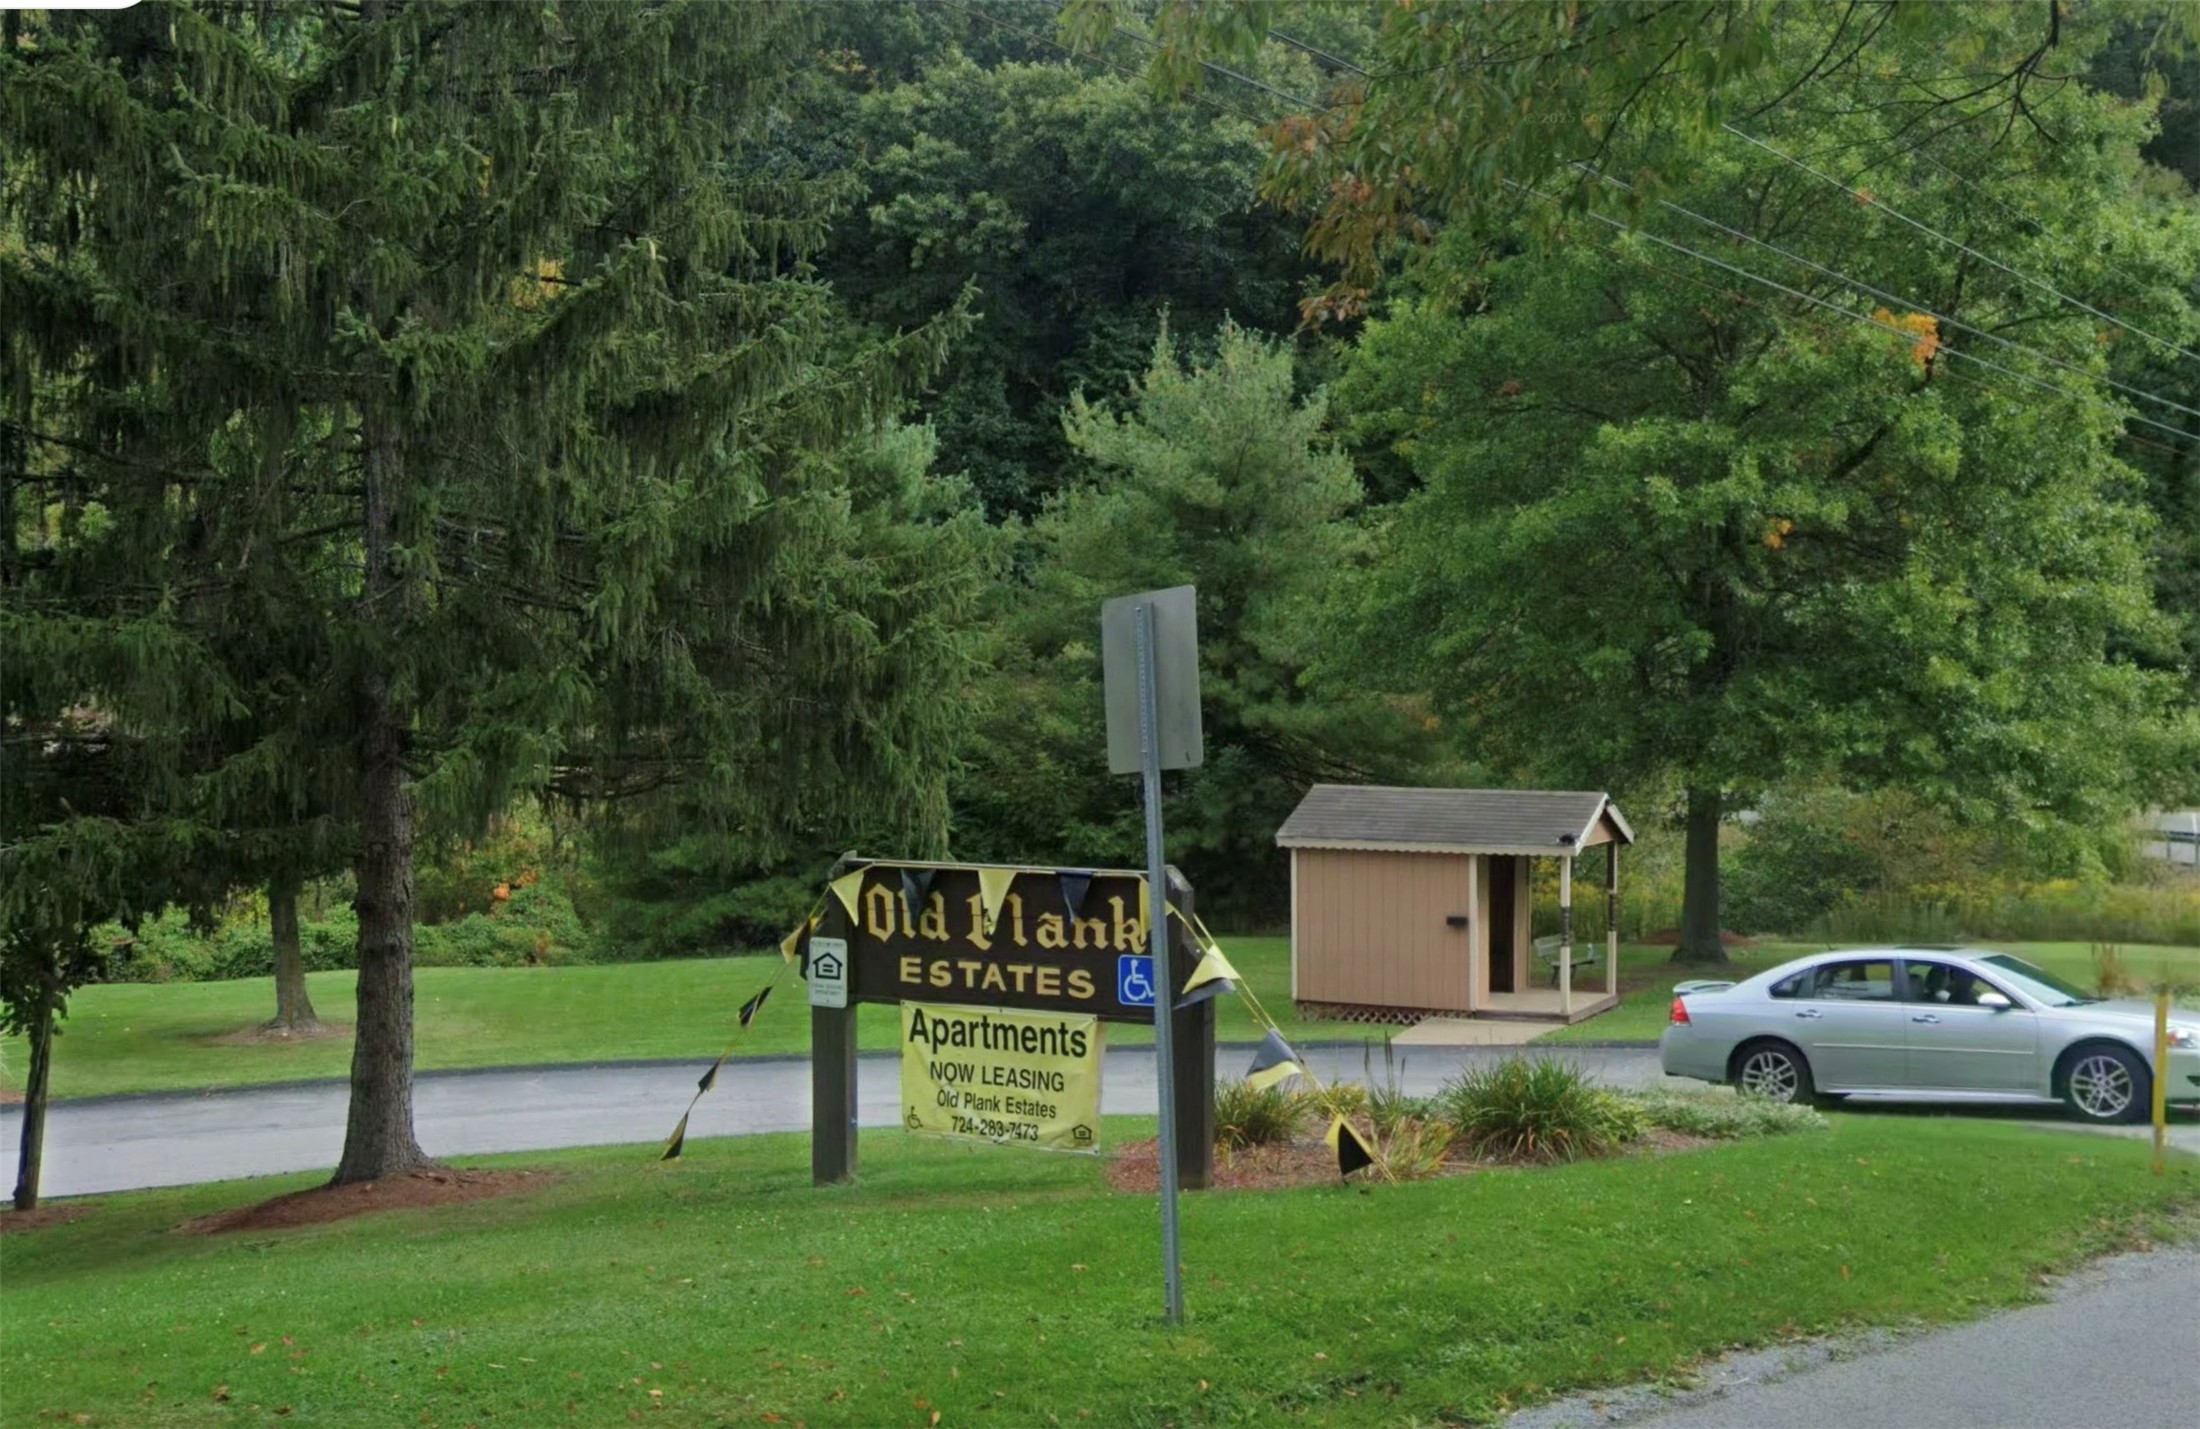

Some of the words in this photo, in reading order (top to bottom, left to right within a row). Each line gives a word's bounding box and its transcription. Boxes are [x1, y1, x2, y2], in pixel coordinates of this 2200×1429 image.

[866, 883, 950, 942] Old
[900, 957, 1095, 999] ESTATES
[909, 1008, 1087, 1058] Apartments
[930, 1061, 974, 1083] NOW
[982, 1065, 1064, 1092] LEASING
[936, 1089, 958, 1108] Old
[964, 1092, 1000, 1113] Plank
[1005, 1096, 1057, 1119] Estates
[951, 1115, 1039, 1142] 724-283-7473
